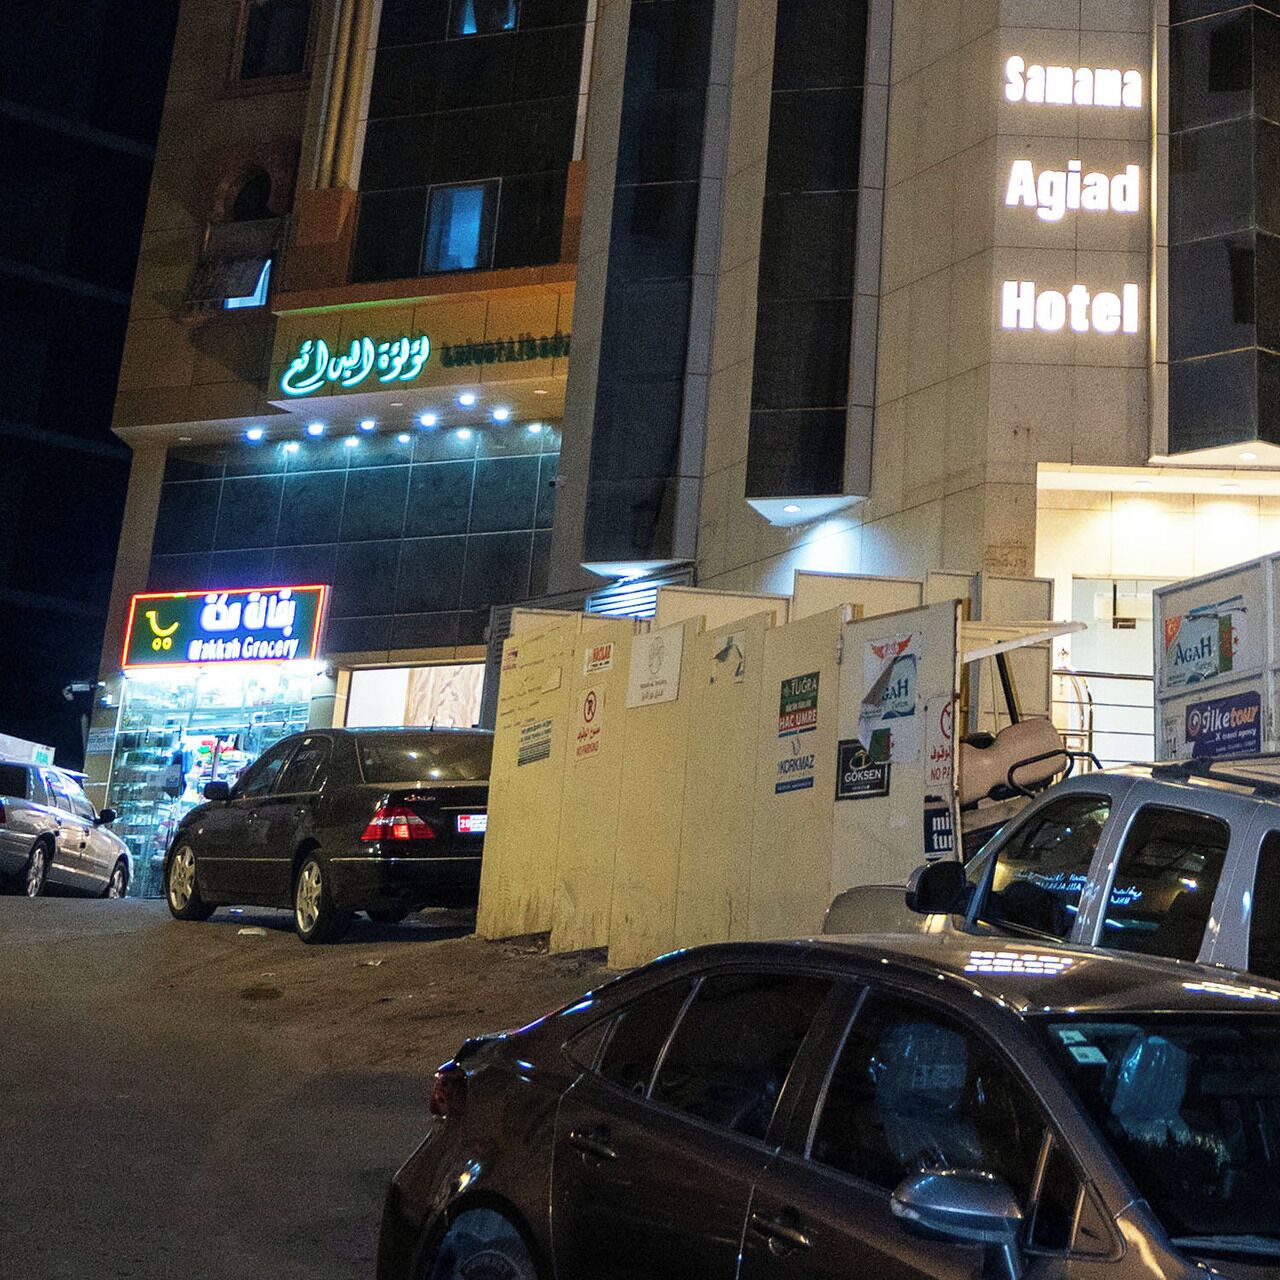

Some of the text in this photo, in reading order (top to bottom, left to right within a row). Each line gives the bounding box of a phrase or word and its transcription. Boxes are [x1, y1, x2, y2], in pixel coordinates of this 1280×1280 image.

[1005, 55, 1142, 108] Samama
[1005, 159, 1140, 221] Agiad
[1001, 280, 1139, 334] Hotel
[243, 588, 297, 638] بقالة
[242, 636, 300, 660] Grocery
[796, 710, 817, 726] UMRE
